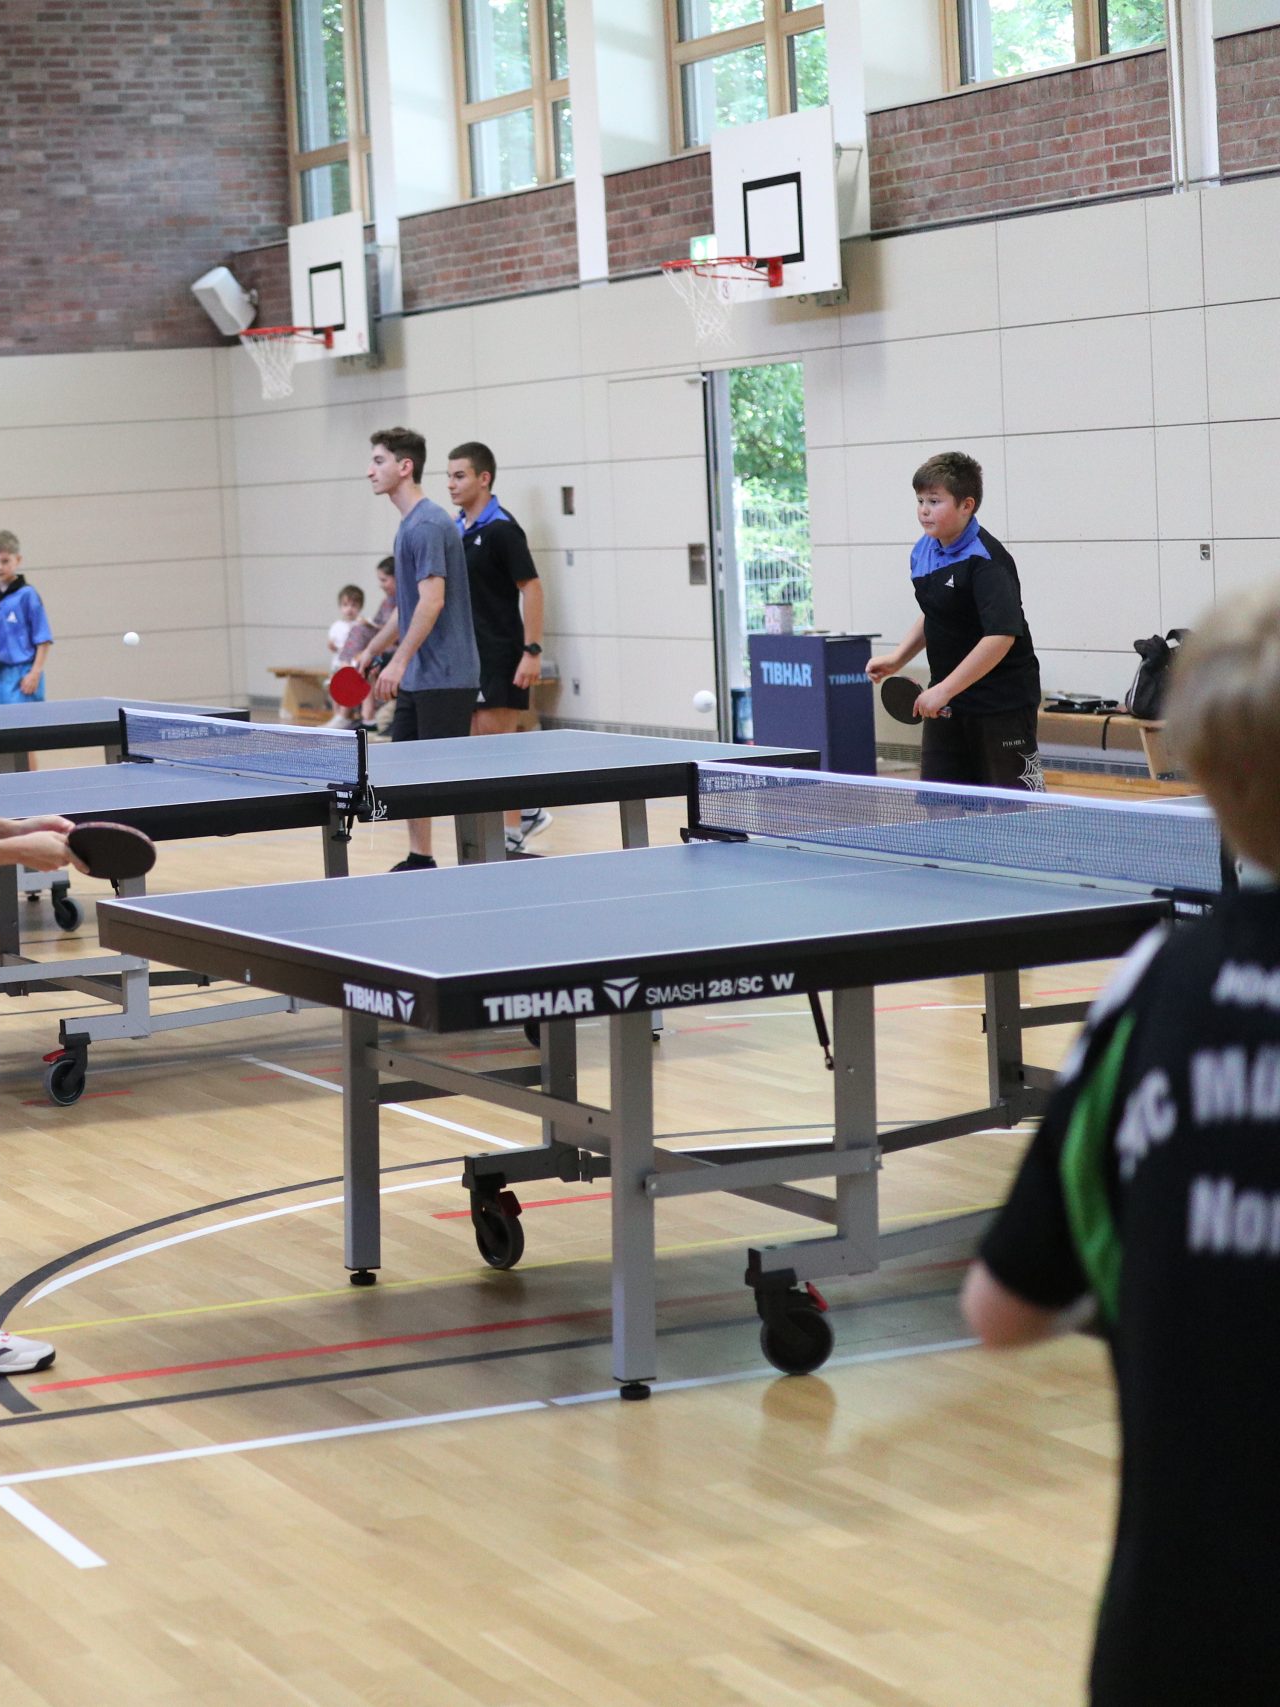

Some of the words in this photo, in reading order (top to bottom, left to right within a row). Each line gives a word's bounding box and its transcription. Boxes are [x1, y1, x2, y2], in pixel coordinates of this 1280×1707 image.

[760, 661, 812, 687] TIBHAR
[343, 983, 395, 1018] TIBHAR
[483, 987, 595, 1022] TIBHAR
[645, 982, 705, 1005] SMASH
[708, 975, 765, 998] 28/SC
[771, 972, 795, 991] W
